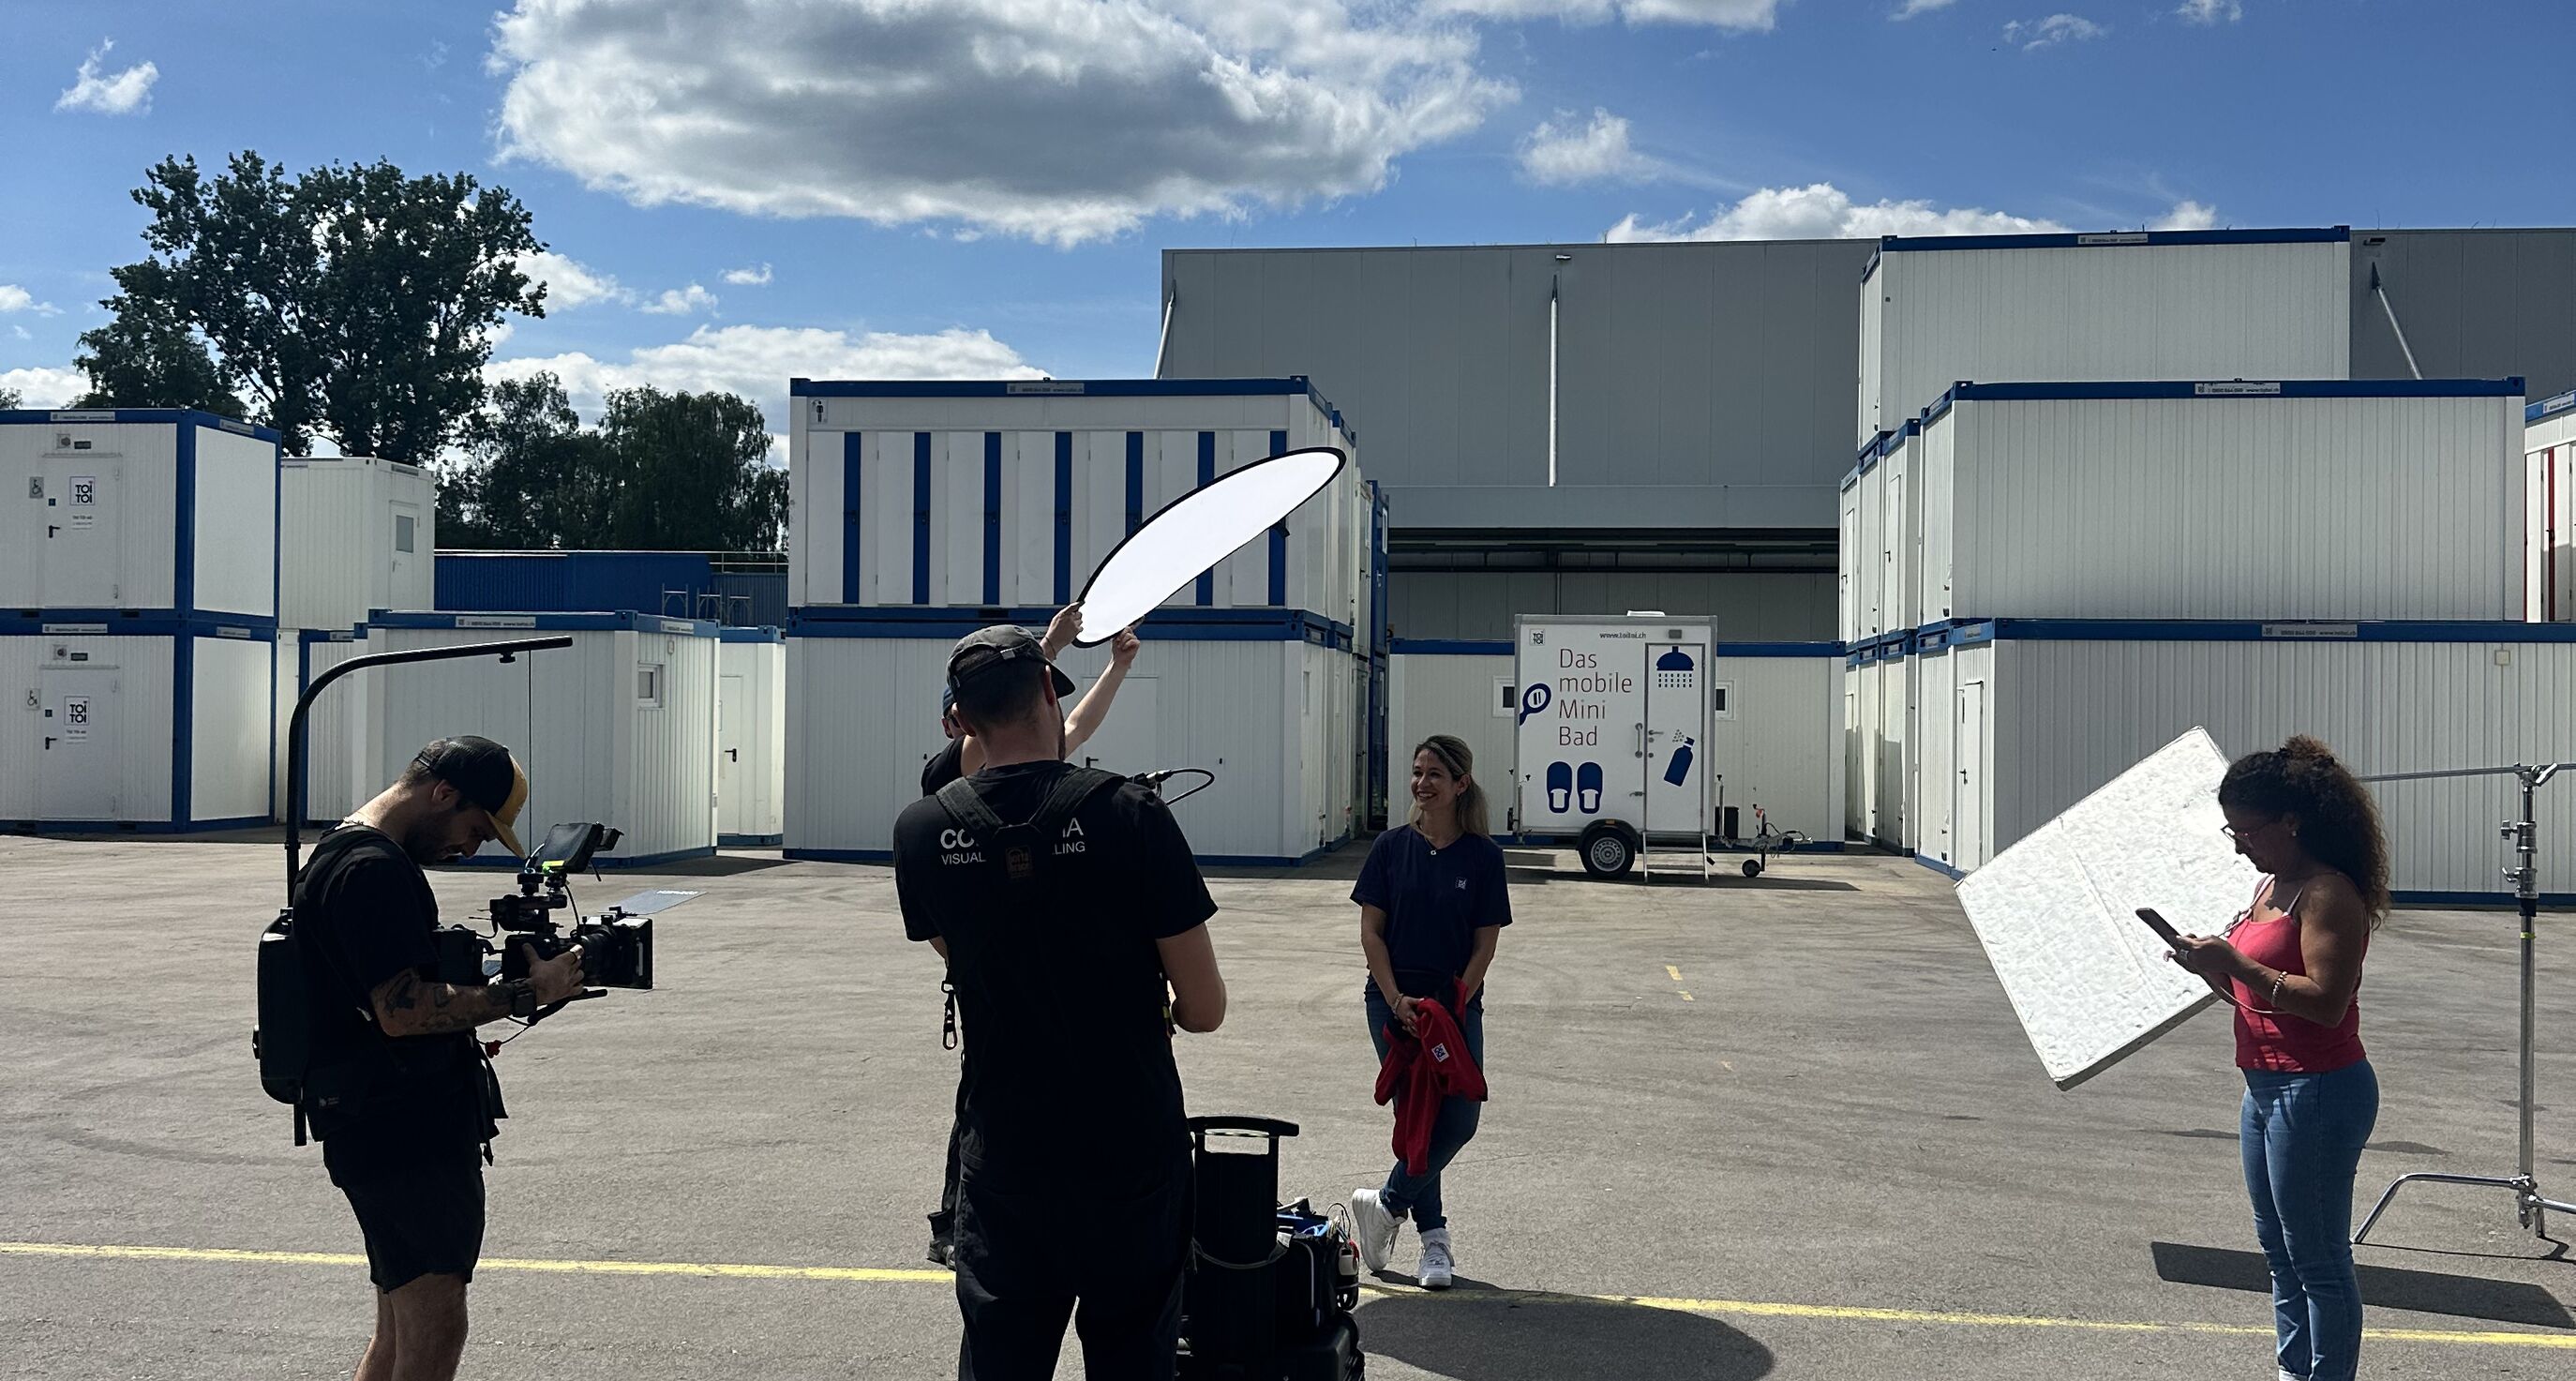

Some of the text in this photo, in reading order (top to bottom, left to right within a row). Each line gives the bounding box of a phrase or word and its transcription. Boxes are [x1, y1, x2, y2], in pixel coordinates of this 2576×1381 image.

[75, 493, 93, 503] TOI
[1560, 648, 1597, 668] Das
[1559, 671, 1632, 693] mobile
[69, 713, 87, 723] TOI
[1559, 698, 1606, 719] Mini
[1559, 725, 1597, 746] Bad
[941, 851, 987, 865] VISUAL
